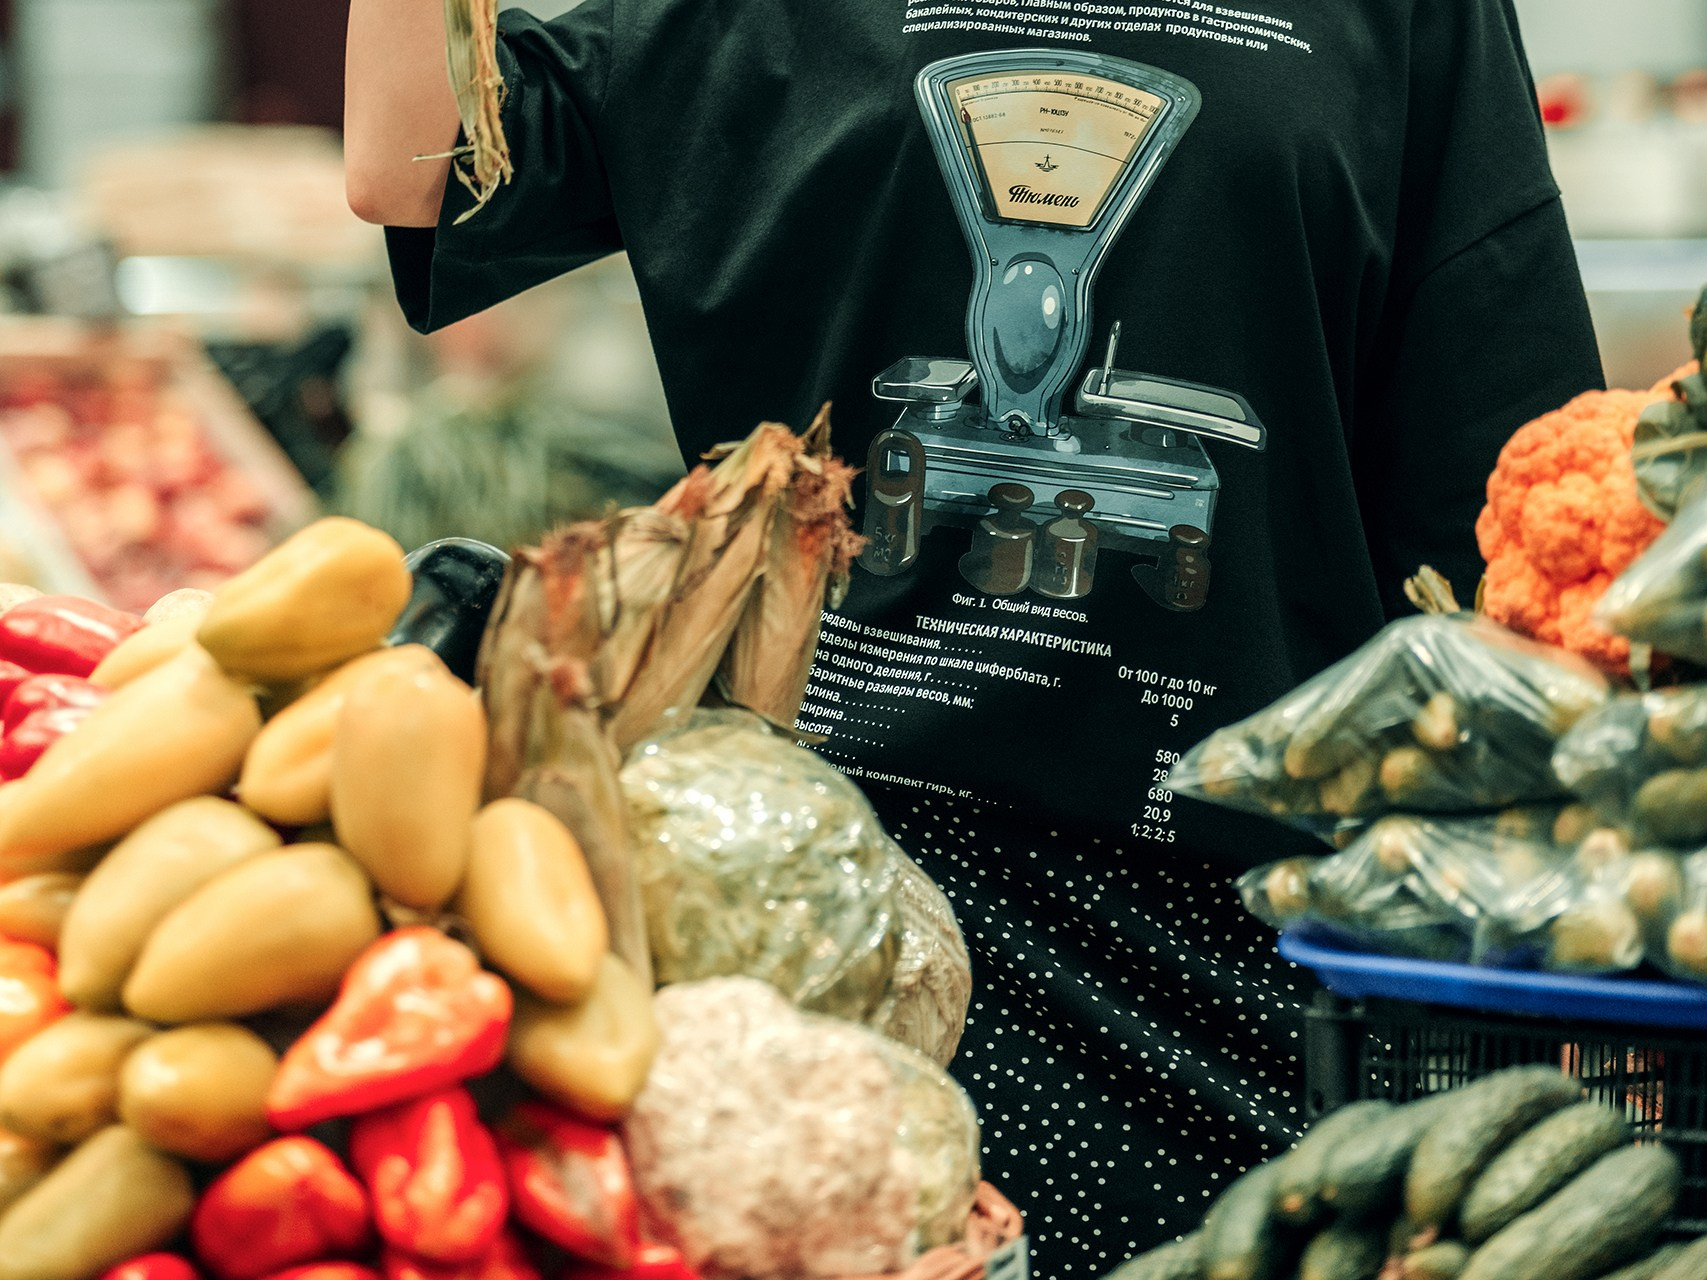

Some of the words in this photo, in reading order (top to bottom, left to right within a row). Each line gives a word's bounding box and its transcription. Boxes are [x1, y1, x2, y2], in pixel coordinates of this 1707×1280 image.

[905, 4, 974, 20] бакалейных,
[976, 9, 1059, 24] кондитерских
[1060, 17, 1068, 25] и
[1069, 18, 1112, 32] других
[1113, 21, 1161, 33] отделах
[1165, 24, 1244, 45] продуктовых
[1246, 39, 1269, 51] или
[1073, 2, 1127, 17] образом,
[1128, 6, 1190, 20] продуктов
[1192, 14, 1199, 22] в
[1201, 15, 1313, 54] гастрономических,
[1192, 1, 1213, 13] для
[1215, 6, 1293, 31] взвешивания
[902, 19, 1025, 35] специализированных
[1026, 27, 1092, 43] магазинов.
[1008, 184, 1080, 208] Тюмень
[819, 609, 861, 633] ределы
[952, 593, 976, 607] Фиг.
[992, 598, 1030, 615] Общий
[1031, 606, 1051, 618] вид
[1053, 608, 1089, 623] весов.
[915, 615, 999, 638] ТЕХНИЧЕСКАЯ
[999, 627, 1112, 658] ХАРАКТЕРИСТИКА
[814, 648, 830, 661] на
[831, 654, 874, 674] одного
[873, 664, 923, 683] деления,
[817, 629, 858, 651] еделы
[859, 643, 923, 665] измерения
[924, 655, 938, 666] по
[938, 656, 973, 671] шкале
[974, 661, 1051, 688] циферблата,
[1053, 676, 1062, 688] г.
[808, 664, 865, 690] баритные
[865, 681, 915, 697] размеры
[915, 689, 950, 705] весов,
[952, 695, 975, 709] мм:
[1118, 666, 1133, 680] От
[1135, 669, 1158, 684] 100
[1160, 675, 1168, 686] г
[1167, 677, 1184, 690] до
[1186, 679, 1201, 693] 10
[1202, 684, 1218, 696] кг
[1140, 690, 1159, 704] До
[1161, 692, 1194, 711] 1000
[1169, 713, 1179, 727] 5
[1155, 749, 1181, 765] 580
[865, 770, 925, 788] комплект
[926, 781, 956, 797] гирь,
[1152, 768, 1169, 783] 28
[1147, 786, 1173, 803] 680
[1142, 805, 1171, 823] 20,9
